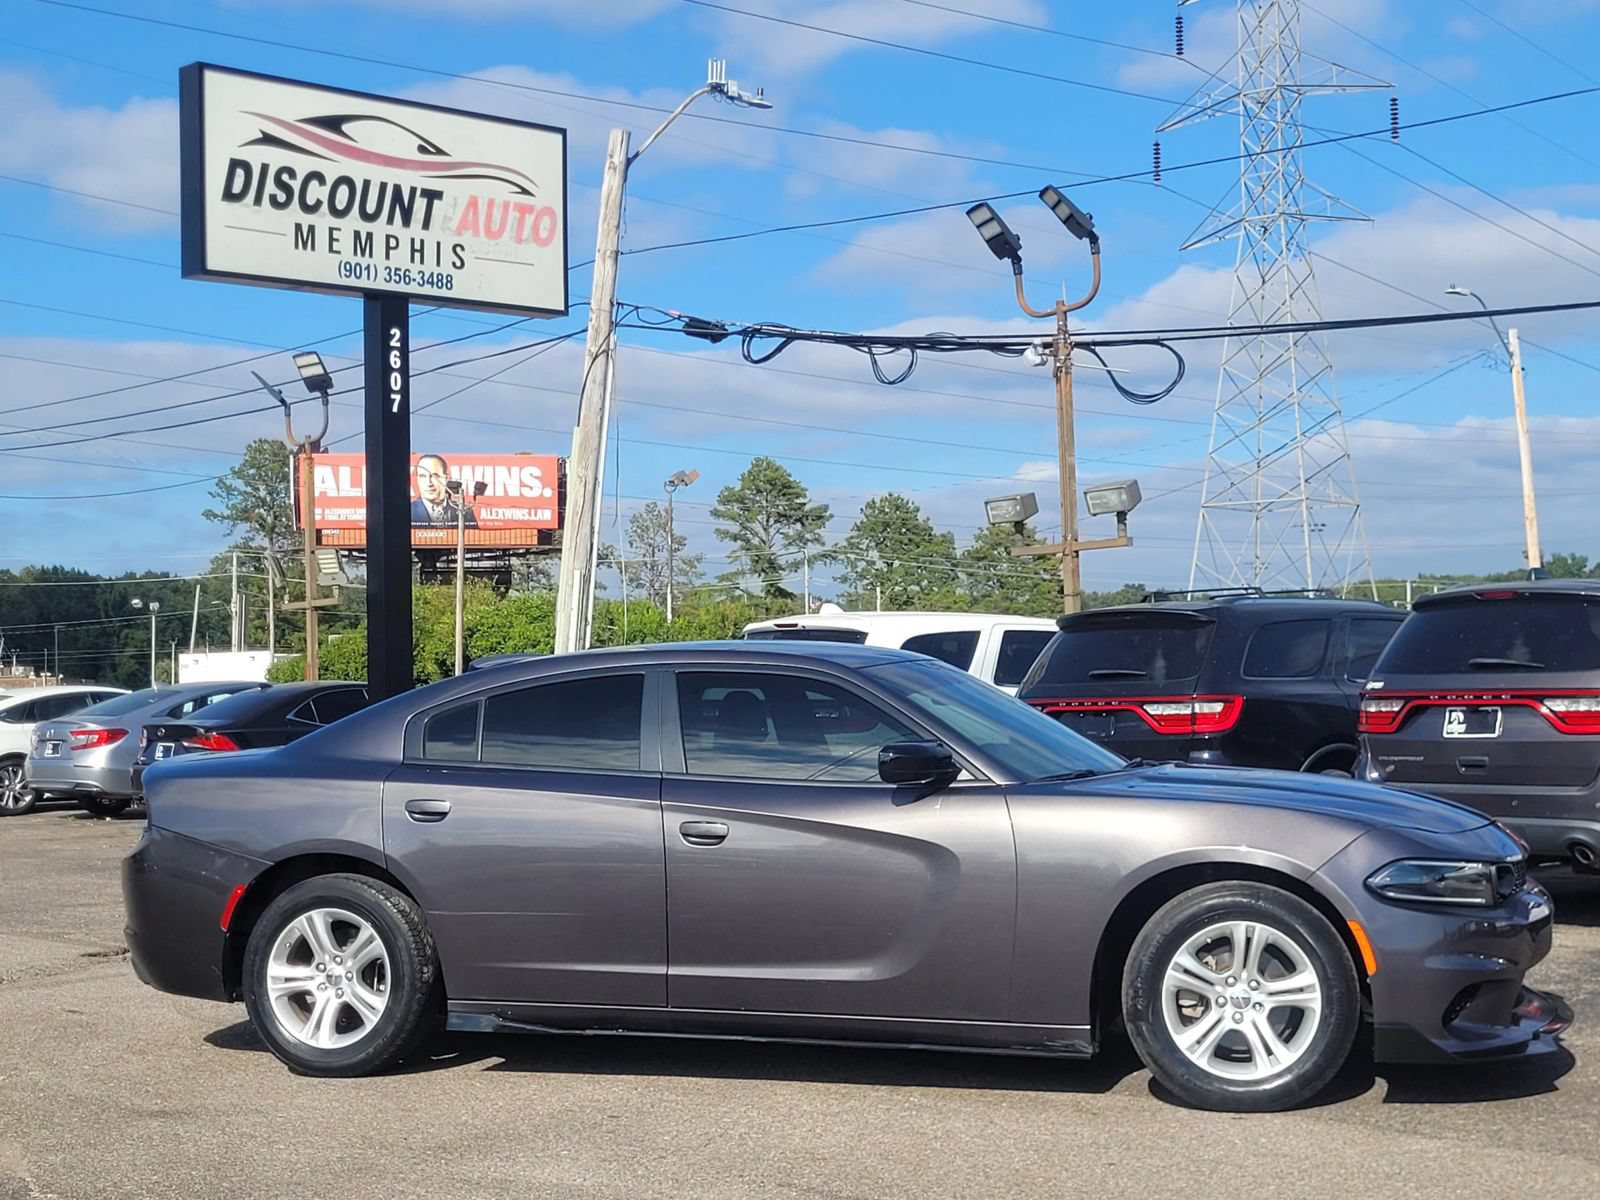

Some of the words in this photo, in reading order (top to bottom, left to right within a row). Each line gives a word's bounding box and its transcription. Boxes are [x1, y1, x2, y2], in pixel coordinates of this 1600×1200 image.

[221, 157, 444, 231] DISCOUNT
[454, 194, 558, 248] AUTO
[293, 223, 466, 270] MEMPHIS
[337, 259, 379, 284] (901)
[383, 267, 454, 291] 356-3488
[389, 327, 401, 413] 2607
[450, 465, 553, 498] WINS.
[480, 507, 552, 521] ALEXWINS.LAW
